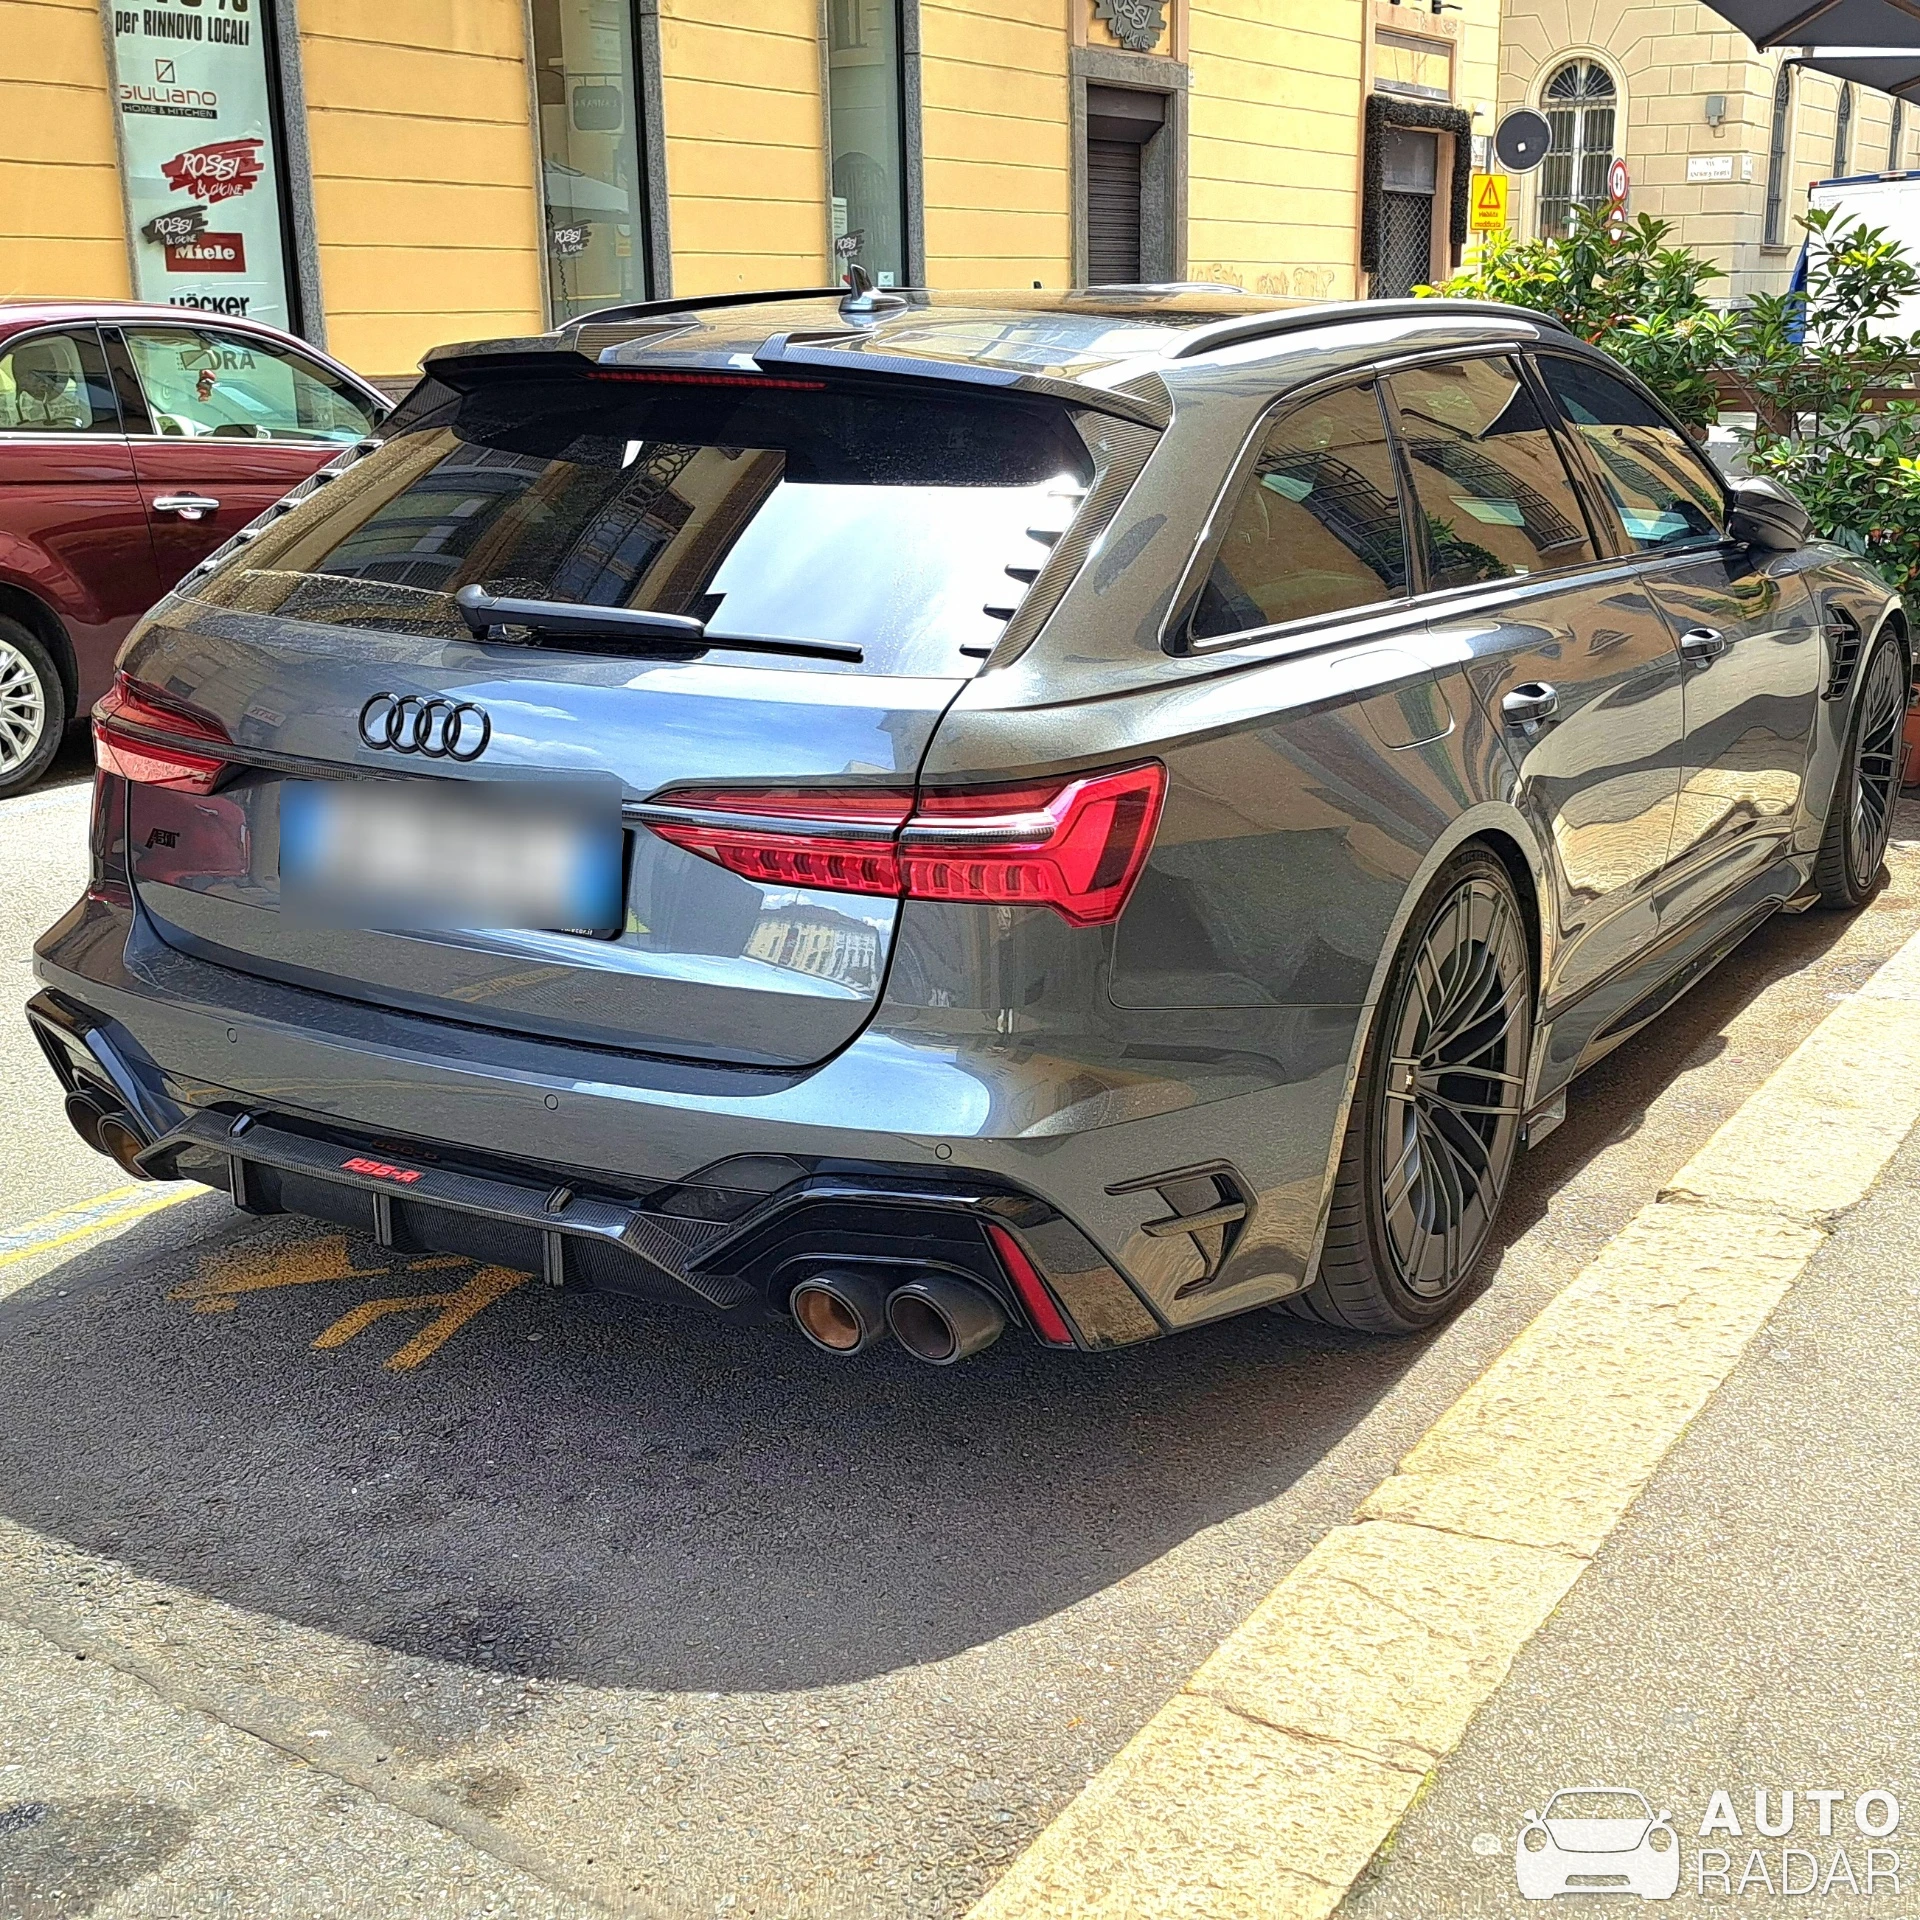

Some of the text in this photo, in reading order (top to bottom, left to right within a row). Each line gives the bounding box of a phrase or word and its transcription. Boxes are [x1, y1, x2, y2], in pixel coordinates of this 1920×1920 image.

[115, 9, 250, 46] per RINNOVO LOCALI
[1107, 0, 1153, 29] OSSI
[123, 104, 157, 114] HOME
[180, 153, 240, 181] ROSSI
[154, 217, 193, 235] ROSSI
[174, 244, 236, 260] Miele
[340, 1157, 423, 1183] RS6-R
